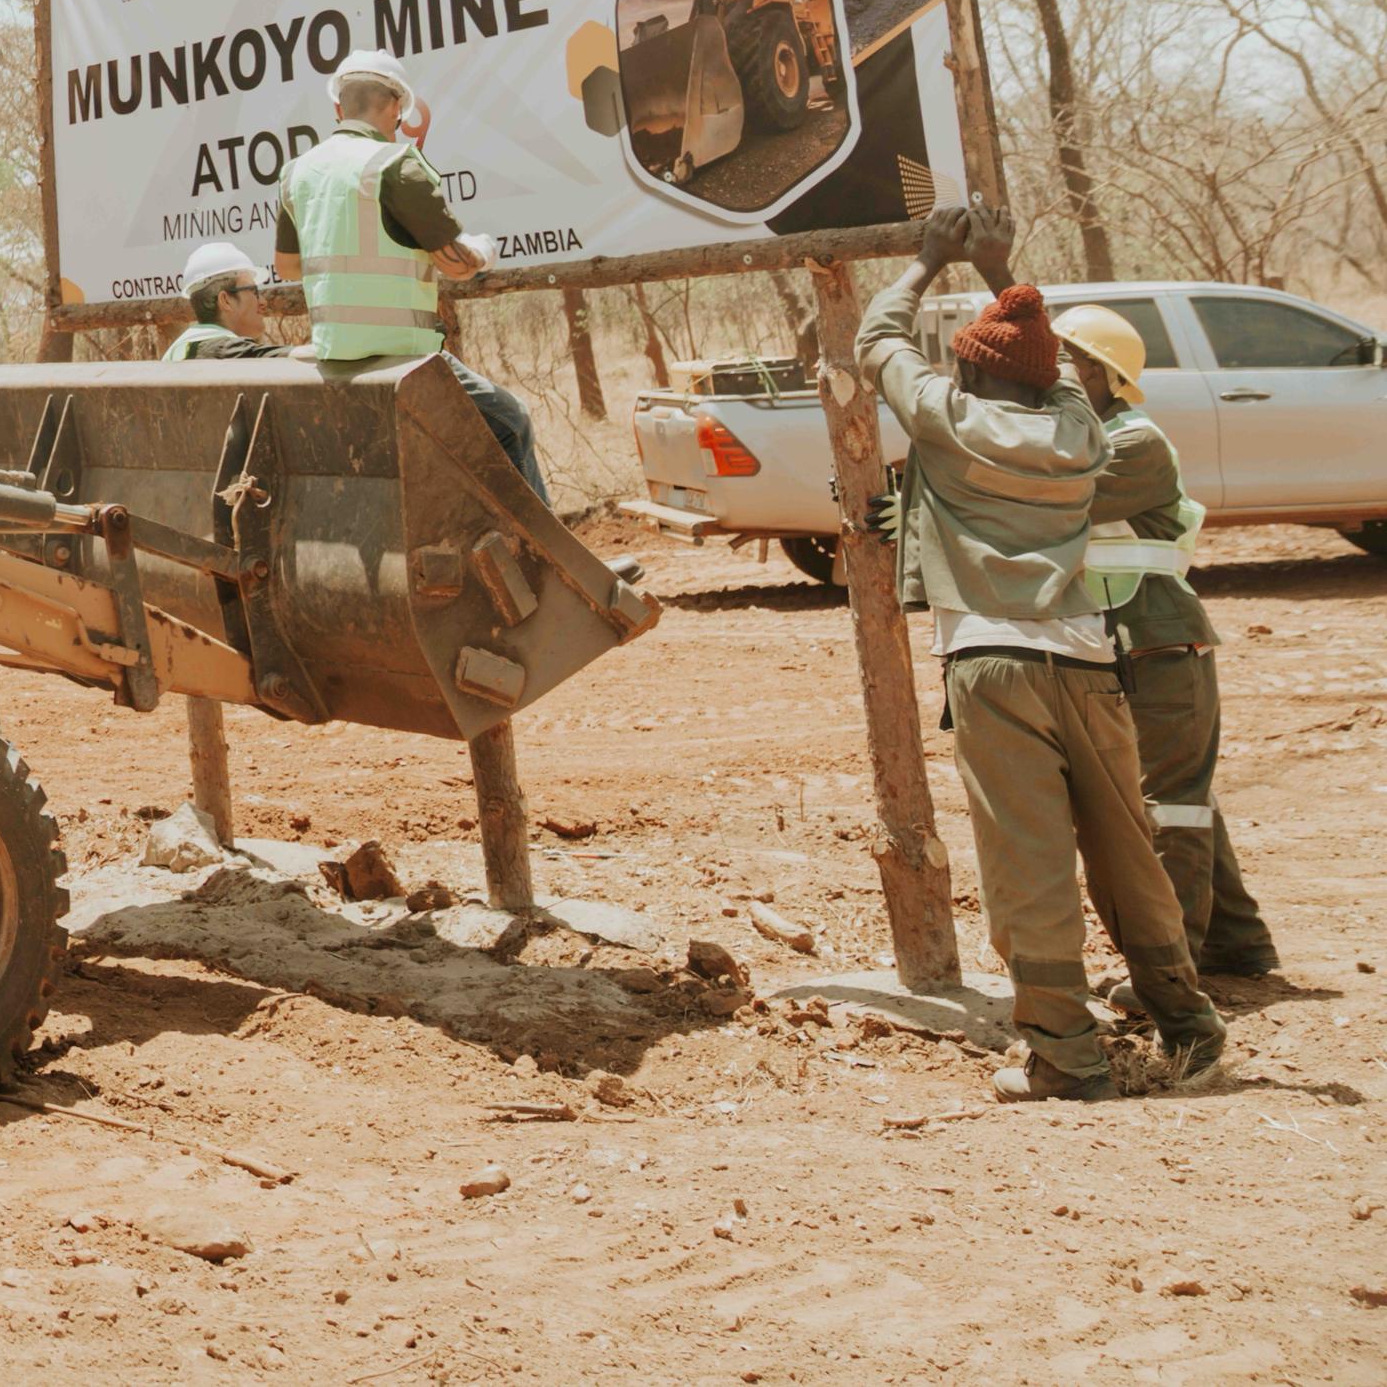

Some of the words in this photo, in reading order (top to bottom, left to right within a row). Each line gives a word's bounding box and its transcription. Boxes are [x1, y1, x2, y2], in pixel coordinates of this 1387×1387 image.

[67, 9, 351, 125] MUNKOYO
[163, 205, 244, 242] MINING
[249, 199, 278, 231] AN
[439, 170, 477, 203] TD
[496, 227, 583, 260] ZAMBIA
